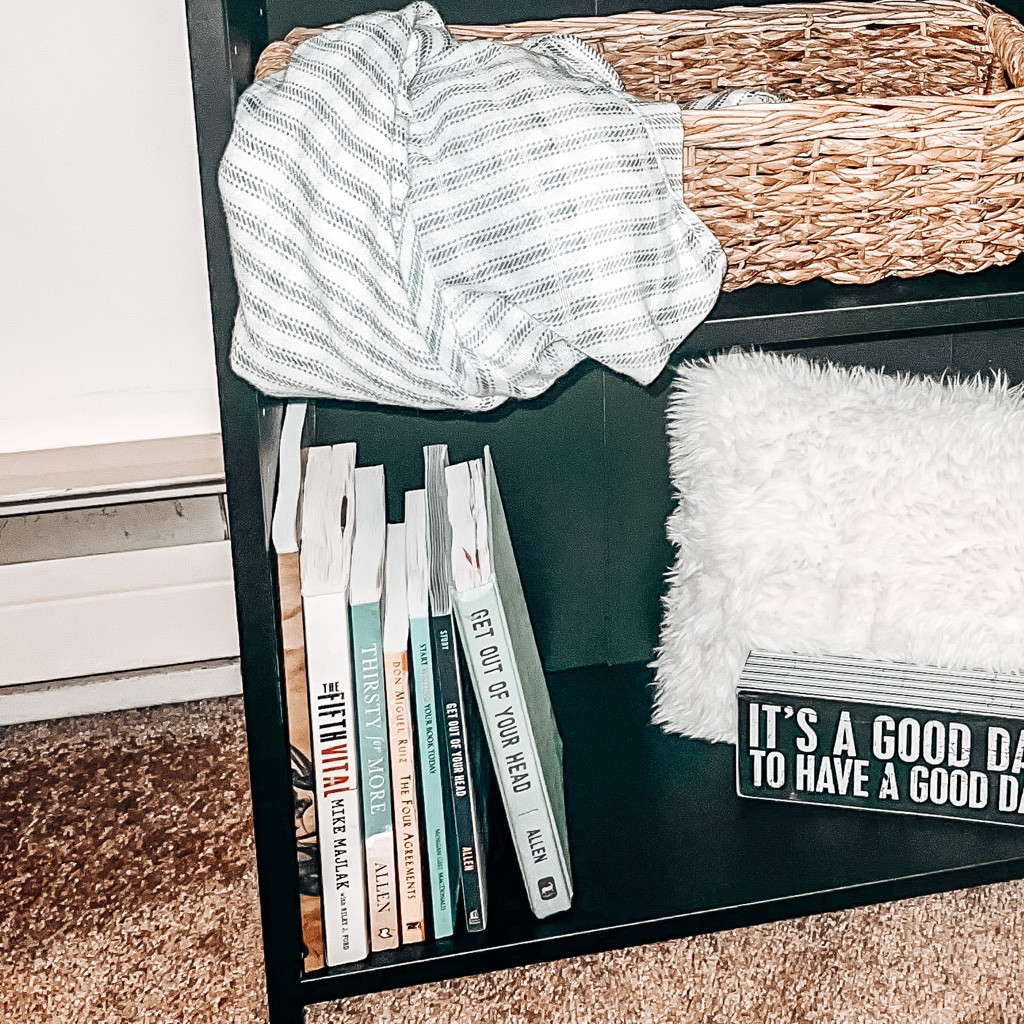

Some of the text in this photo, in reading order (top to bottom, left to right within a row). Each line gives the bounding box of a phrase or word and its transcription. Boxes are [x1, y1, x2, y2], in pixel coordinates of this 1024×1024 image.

[419, 643, 428, 666] START
[439, 629, 449, 651] STUDY
[322, 681, 340, 694] THE
[470, 608, 531, 794] GET OUT OF YOUR HEAD
[361, 642, 386, 815] THIRSTY for MORE
[393, 661, 408, 763] DON MIGUEL RUIZ
[424, 703, 433, 725] YOUR
[317, 692, 350, 798] FIFTH VITAL
[426, 726, 435, 749] BOOK
[446, 702, 467, 797] GET OUT OF YOUR HEAD
[749, 702, 818, 753] IT'S
[832, 711, 857, 757] A
[872, 715, 972, 767] GOOD
[427, 749, 437, 774] TODAY
[749, 750, 786, 789] TO
[796, 754, 870, 798] HAVE
[878, 762, 900, 801] A
[909, 766, 988, 809] GOOD
[331, 798, 345, 834] MIKE
[400, 774, 416, 900] THE FOUR AGREEMENTS
[434, 828, 443, 856] MORGAN
[461, 846, 474, 872] ALLEN
[526, 829, 548, 864] ALLEN
[333, 838, 349, 891] MAJLAK
[375, 863, 391, 913] ALLEN
